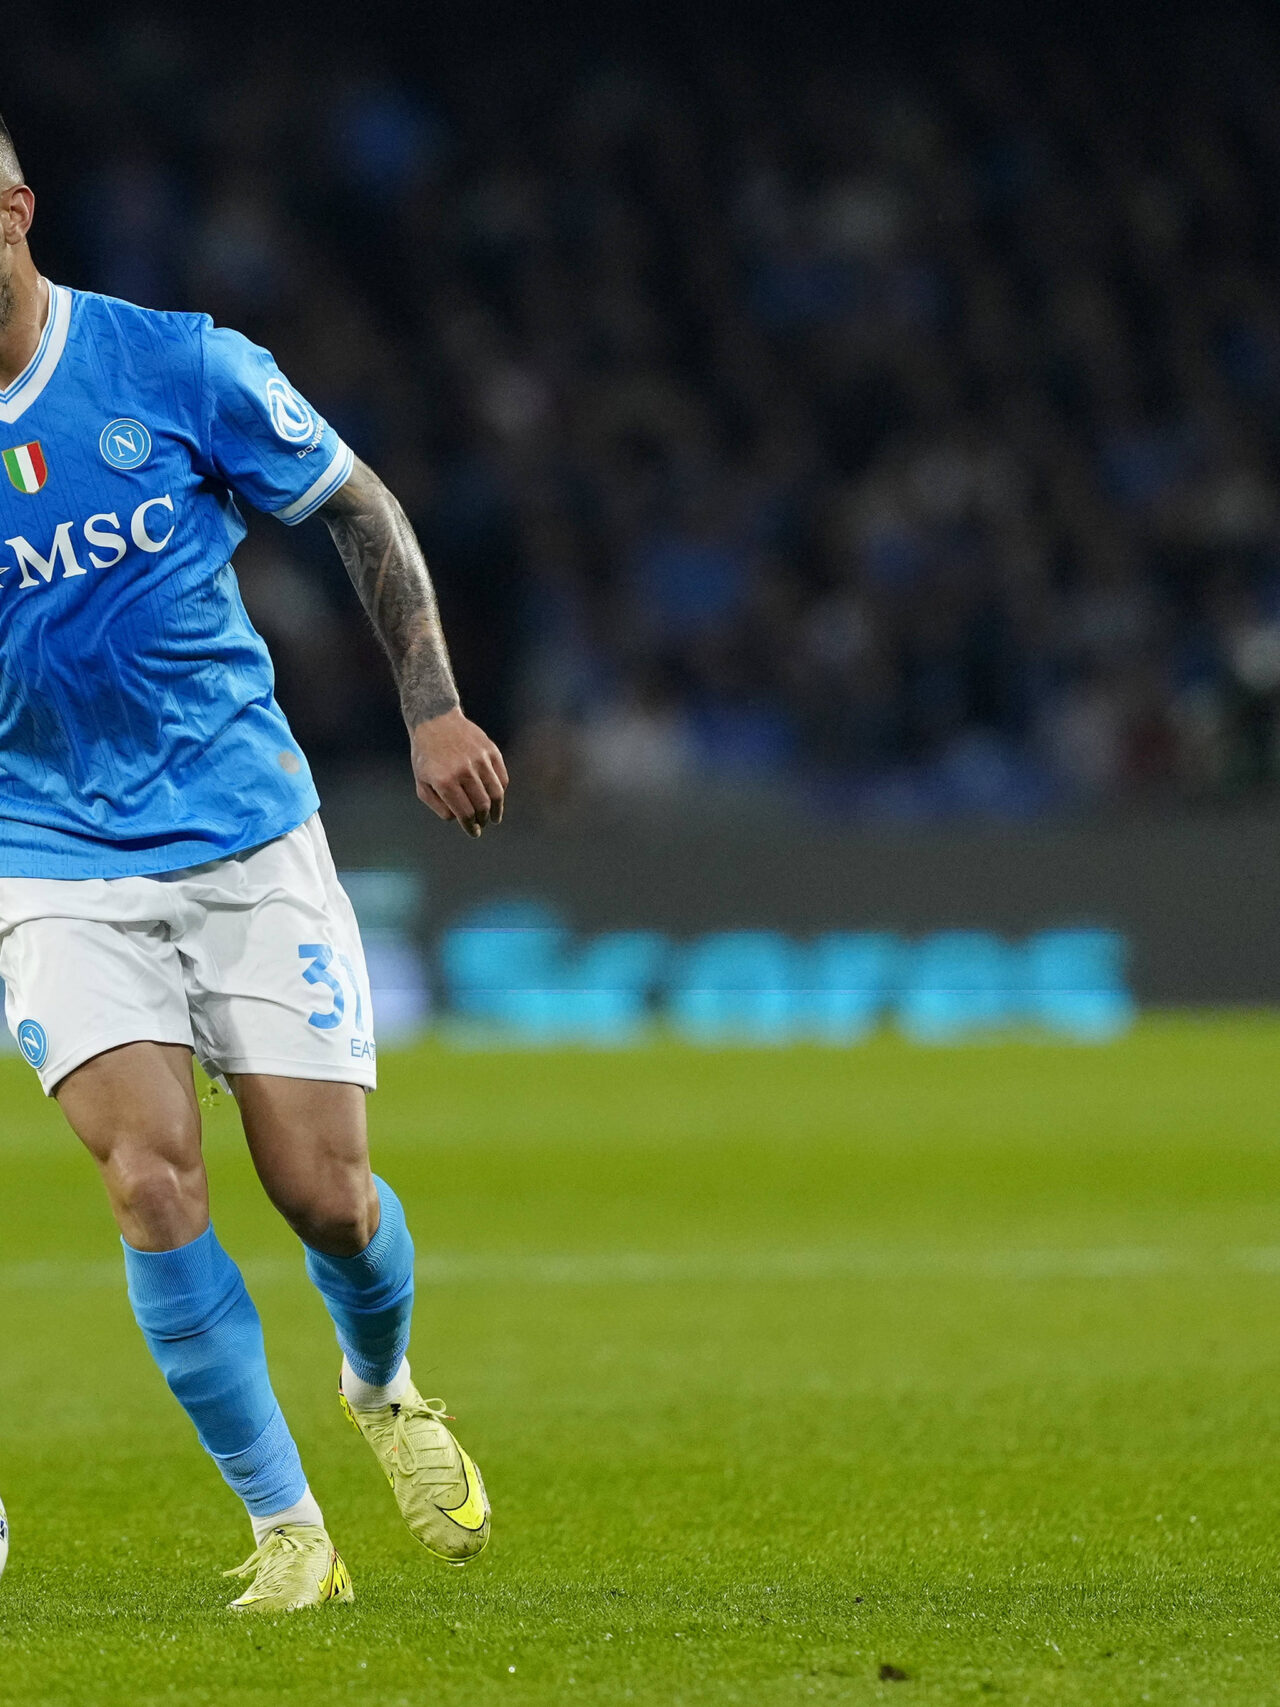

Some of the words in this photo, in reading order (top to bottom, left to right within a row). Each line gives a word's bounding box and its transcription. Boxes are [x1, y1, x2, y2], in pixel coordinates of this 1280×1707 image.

[111, 430, 137, 457] N
[4, 493, 176, 589] MSC
[297, 943, 365, 1032] 31
[22, 1029, 40, 1057] N
